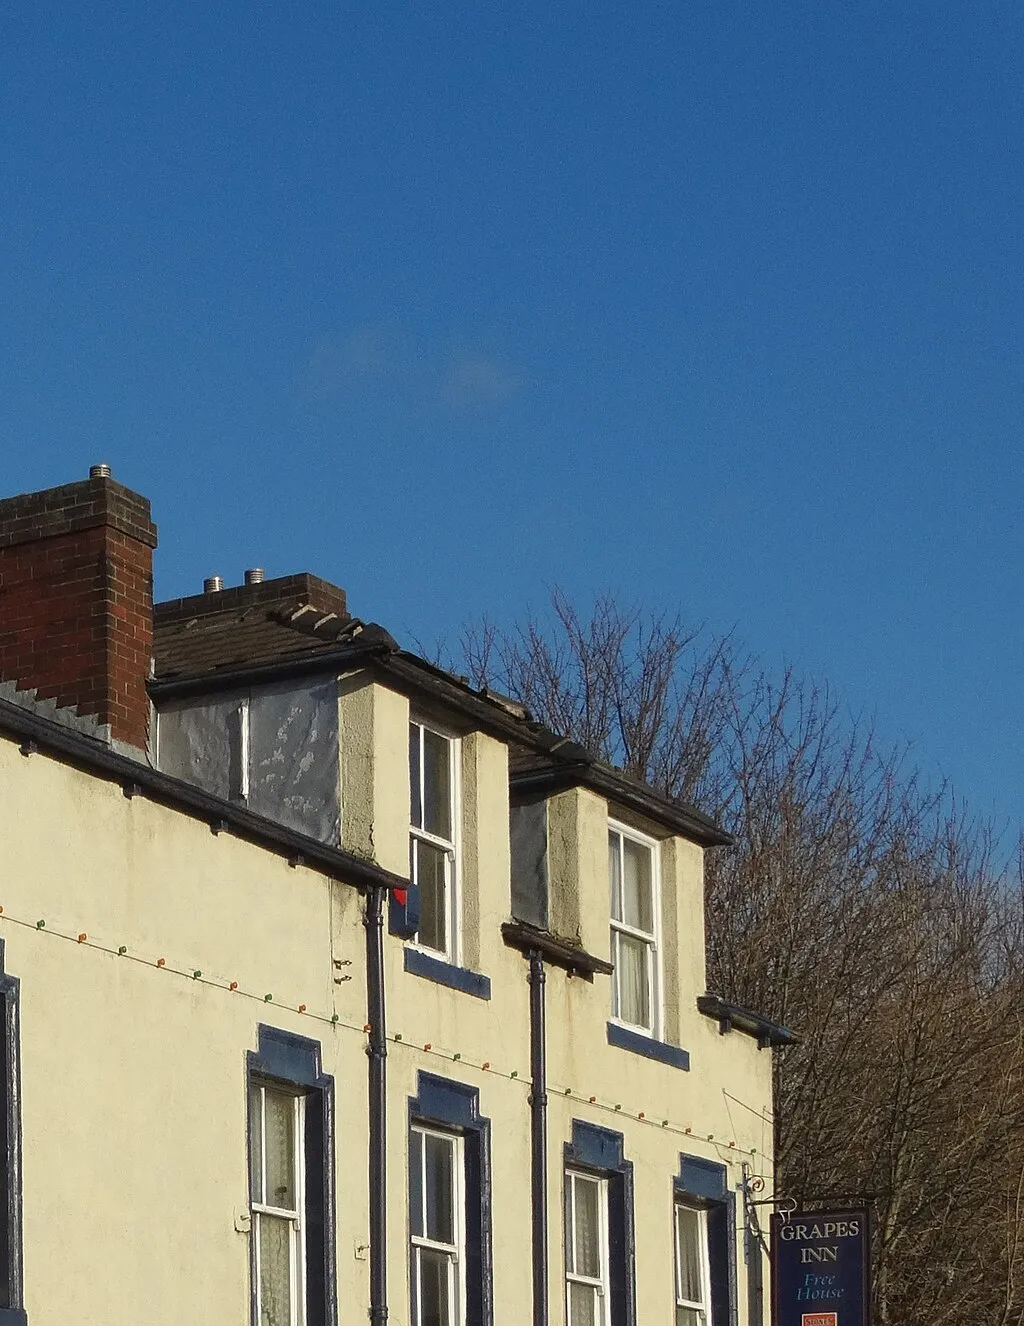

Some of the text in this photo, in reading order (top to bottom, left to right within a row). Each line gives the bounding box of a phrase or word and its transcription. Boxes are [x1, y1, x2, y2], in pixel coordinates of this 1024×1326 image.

[780, 1221, 860, 1241] GRAPES
[800, 1246, 839, 1264] INN
[804, 1273, 836, 1287] Free
[796, 1287, 845, 1301] House
